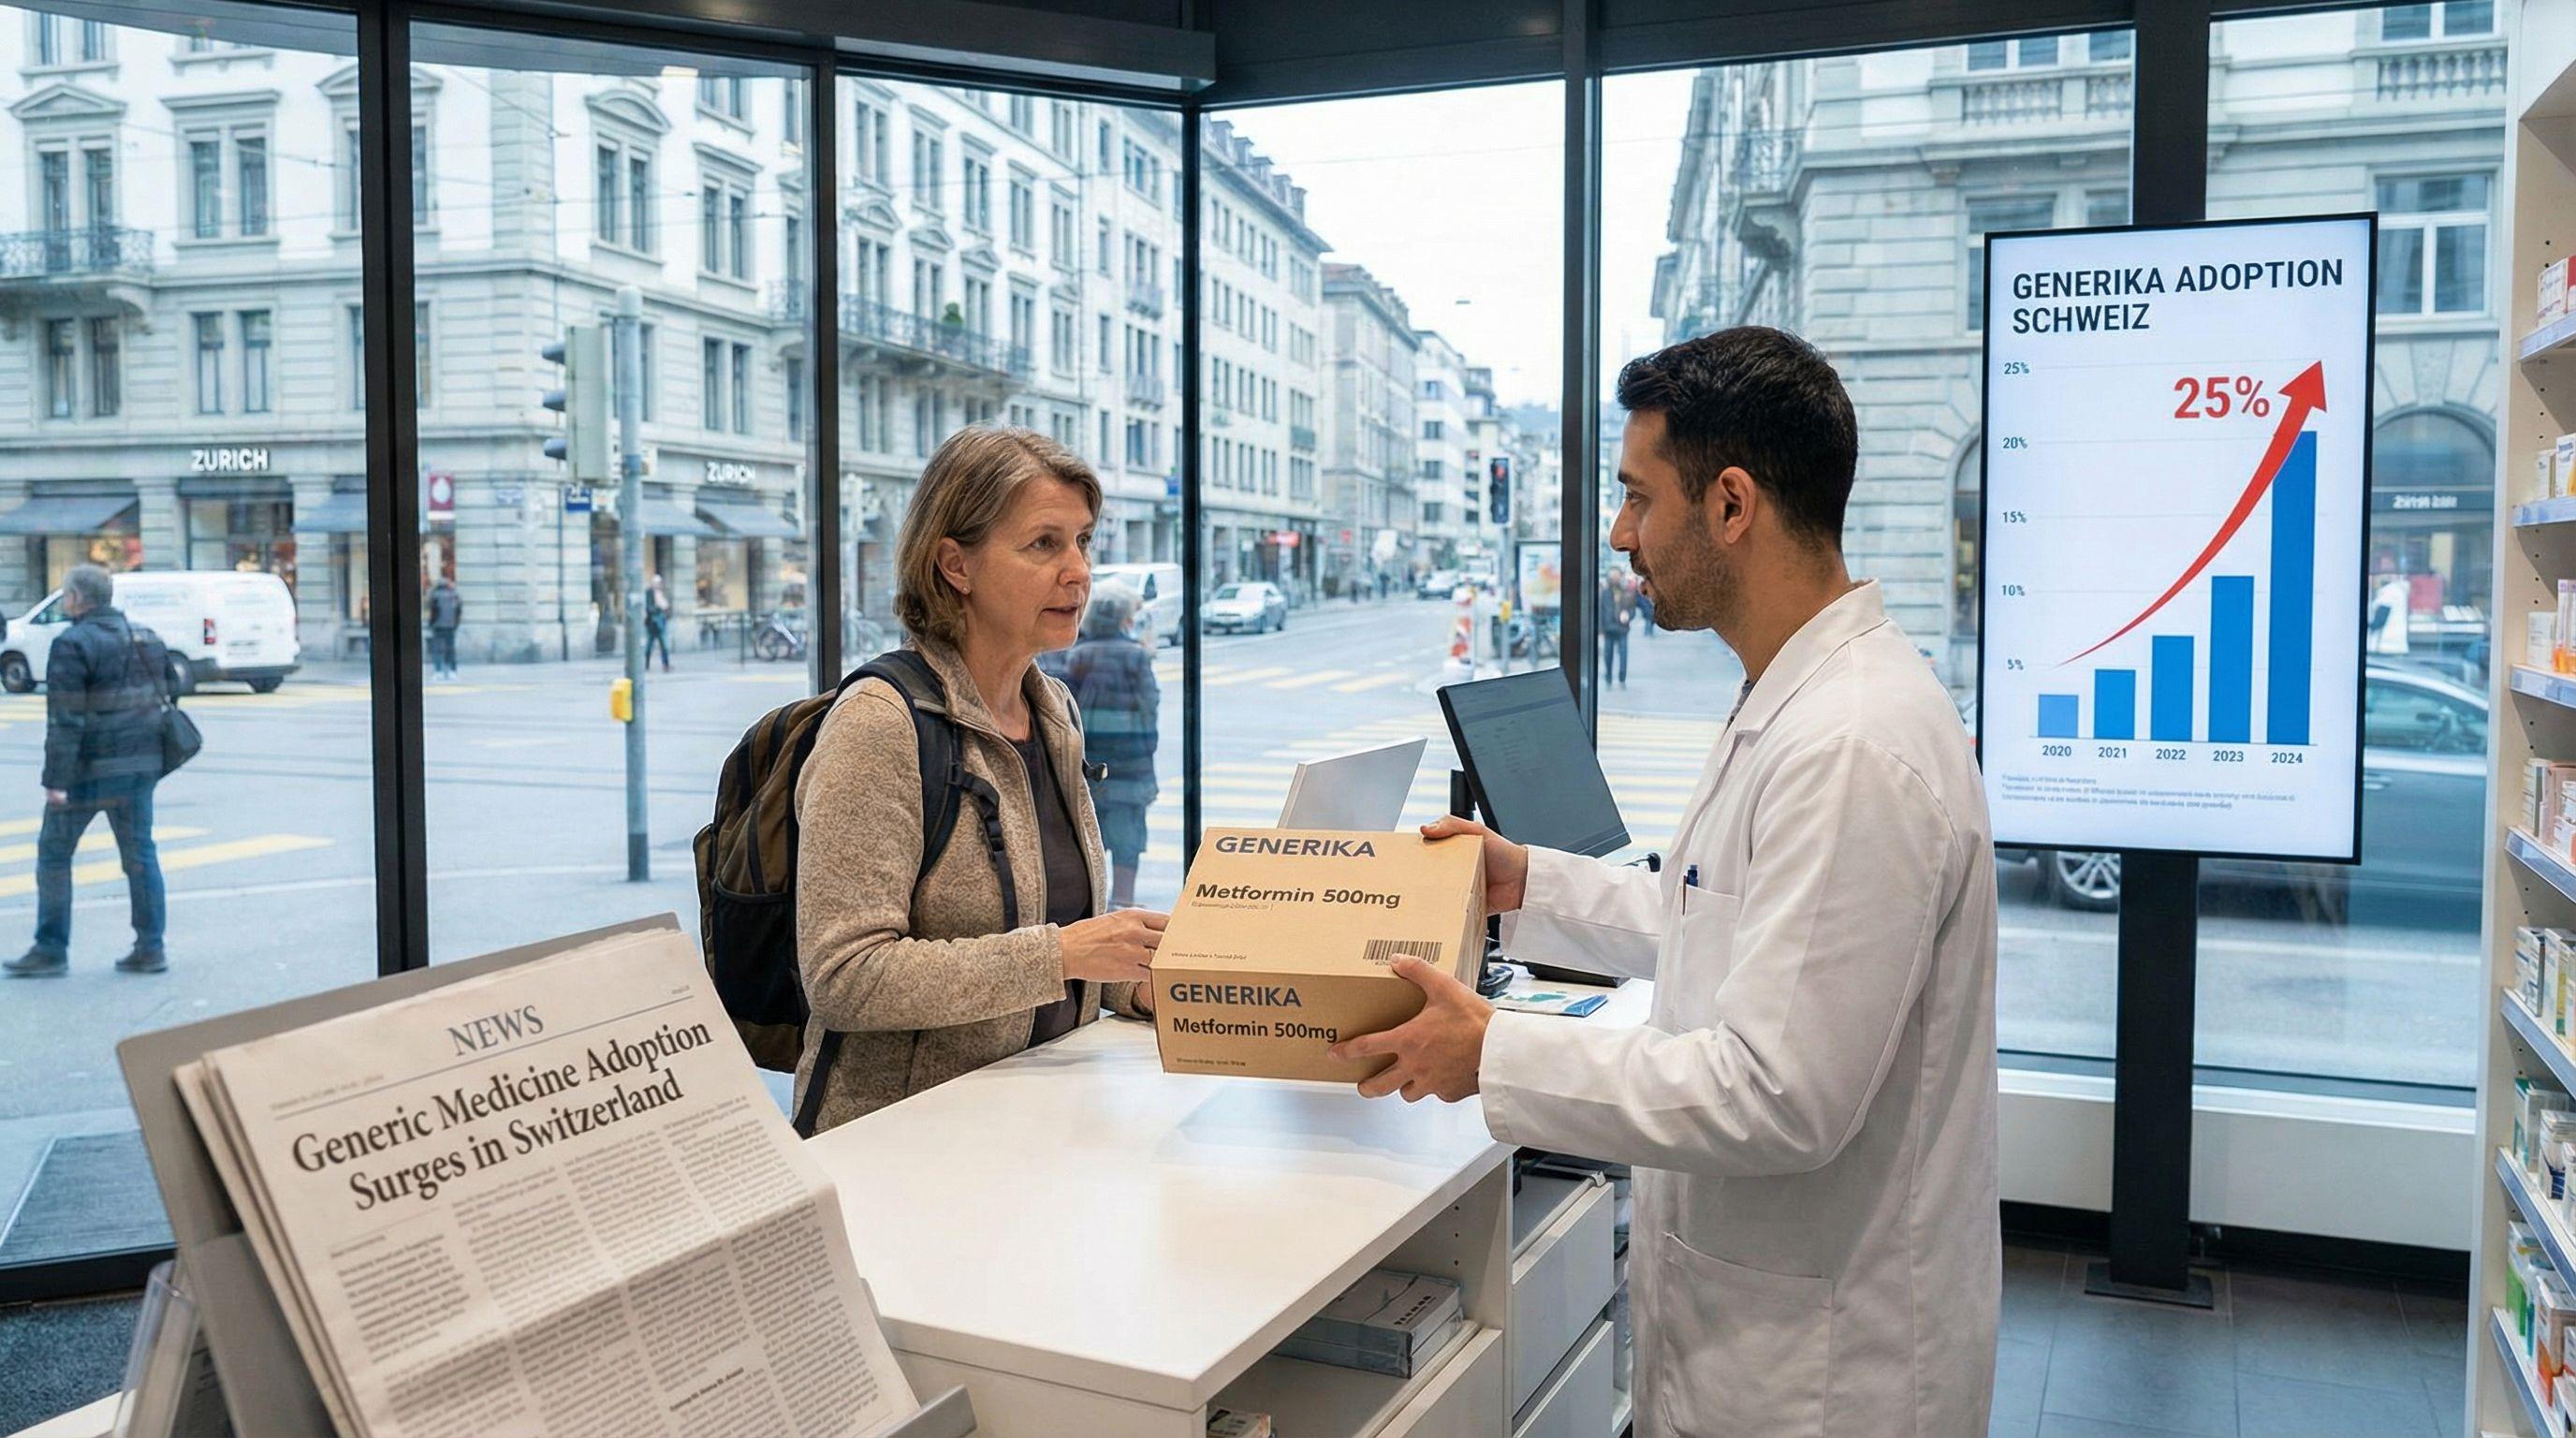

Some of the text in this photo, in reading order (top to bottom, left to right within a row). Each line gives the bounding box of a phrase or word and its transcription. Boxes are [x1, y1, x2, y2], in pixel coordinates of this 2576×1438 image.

[2012, 258, 2343, 300] GENERIKA ADOPTION
[2012, 303, 2150, 333] SCHWEIZ
[2004, 361, 2029, 374] 25%
[2174, 375, 2270, 419] 25%
[2002, 436, 2027, 449] 20%
[191, 448, 269, 472] ZURICH
[2002, 511, 2027, 523] 15%
[2001, 584, 2026, 596] 10%
[2007, 658, 2024, 670] 5%
[2042, 745, 2304, 764] 2020 2021 2022 2023 2024
[1216, 835, 1376, 858] GENERIKA
[1195, 883, 1401, 909] Metformin 500mg
[1169, 982, 1302, 1008] GENERIKA
[447, 1005, 545, 1057] NEWS
[1173, 1018, 1338, 1044] Metformin 500mg
[292, 1106, 433, 1172] Generic
[432, 1061, 580, 1130] Medicine
[586, 1021, 714, 1084] Adoption
[349, 1066, 685, 1211] Surges in Switzerland
